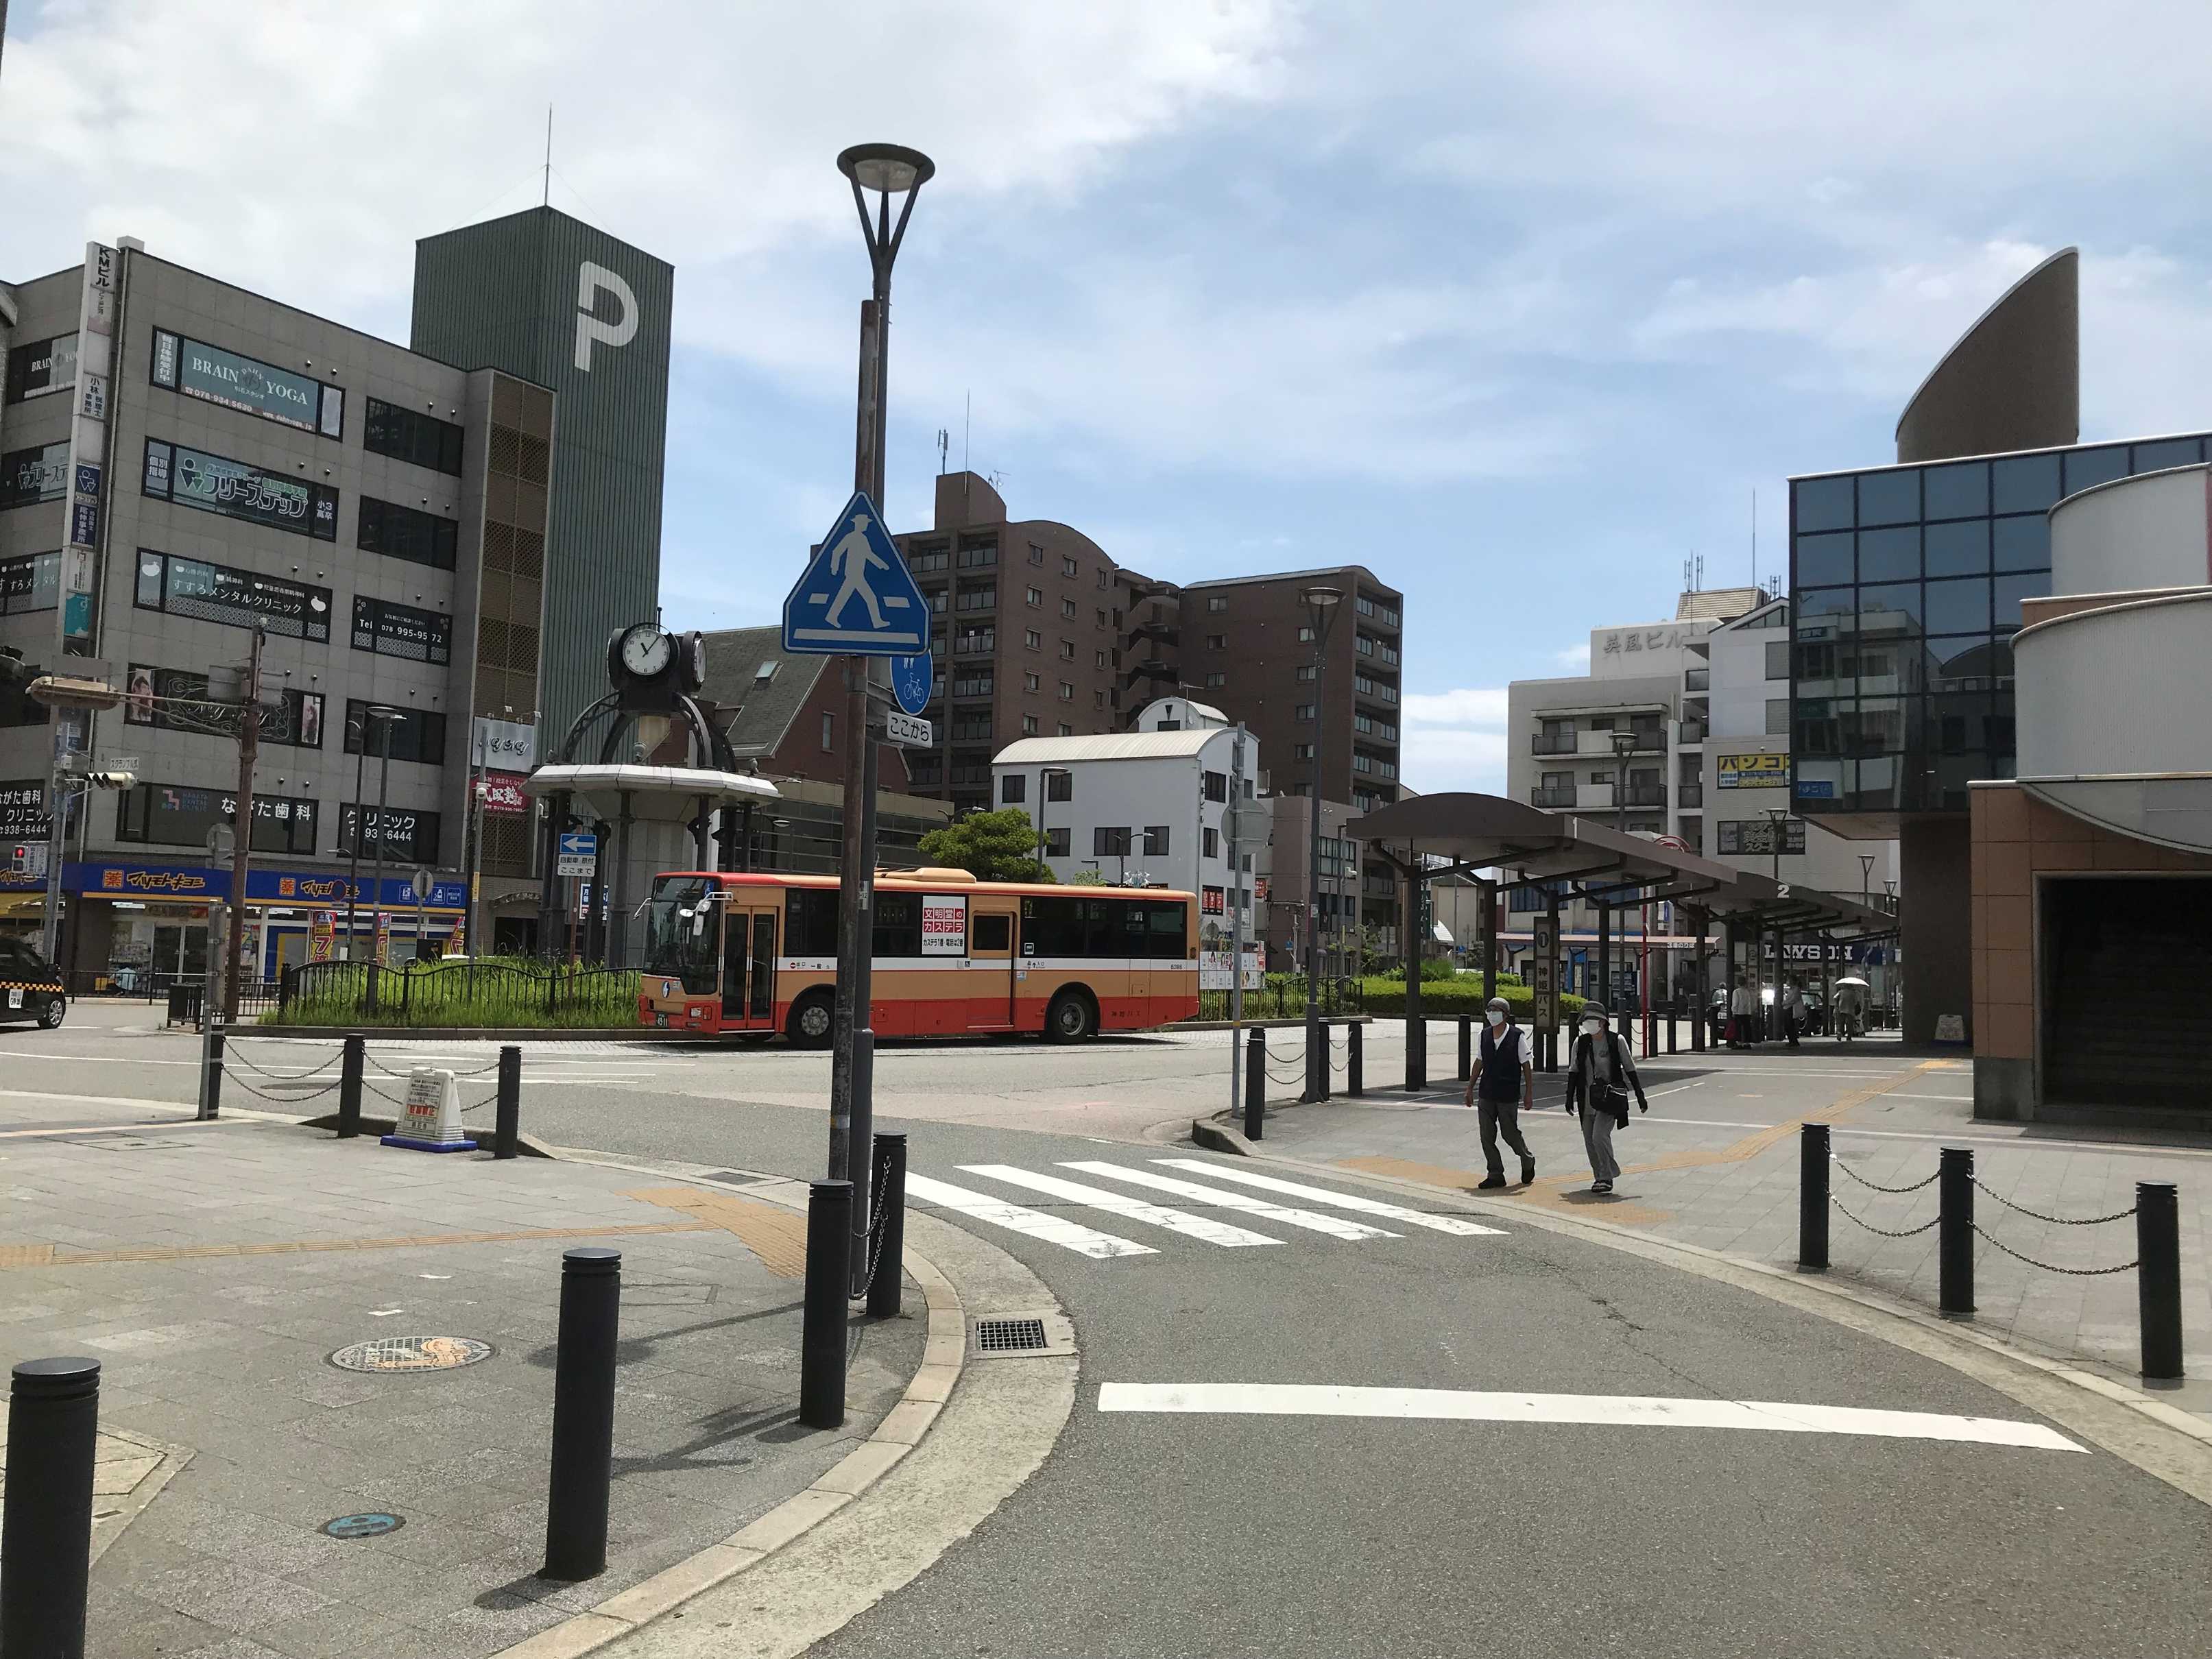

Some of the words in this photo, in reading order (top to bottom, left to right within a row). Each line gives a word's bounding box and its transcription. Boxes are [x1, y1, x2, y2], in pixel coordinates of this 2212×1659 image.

[97, 247, 110, 287] KMビル
[575, 261, 639, 372] P
[192, 356, 239, 383] BRAIN
[266, 380, 309, 406] YOGA
[149, 455, 168, 468] 個別
[203, 472, 309, 518] フリーステップ
[317, 500, 333, 511] 小3
[359, 619, 373, 629] Tel
[381, 625, 394, 633] 078
[890, 716, 929, 742] ここから
[1721, 757, 1790, 770] パソコ
[221, 797, 311, 821] なた歯科
[4, 824, 47, 835] 938-6444
[365, 827, 412, 842] 93-6444
[560, 867, 592, 875] ここまで
[104, 871, 122, 887] 薬
[128, 872, 206, 889] マツモトキヨシ
[280, 878, 296, 895] 薬
[1777, 884, 1790, 899] 2
[924, 908, 963, 919] 文明堂の
[924, 923, 963, 932] カステラ
